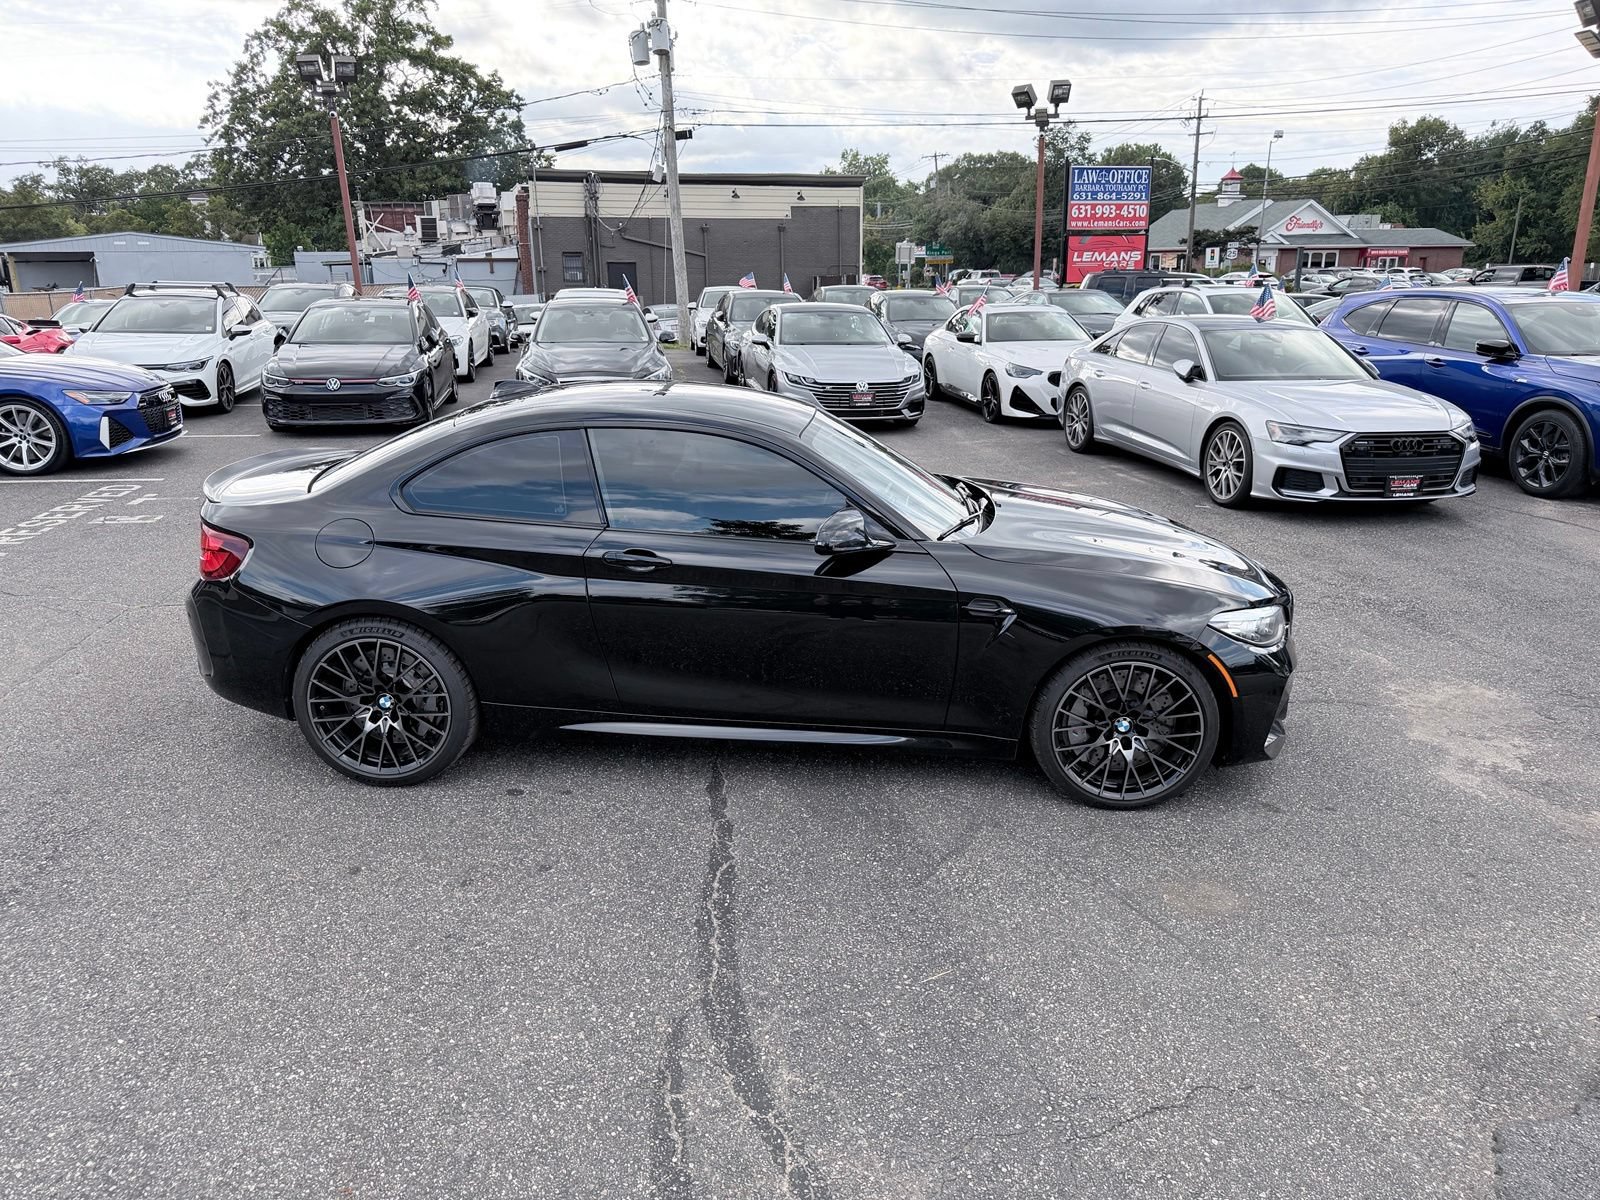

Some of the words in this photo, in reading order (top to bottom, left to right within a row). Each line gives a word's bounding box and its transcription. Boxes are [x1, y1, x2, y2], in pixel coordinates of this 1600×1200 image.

[1074, 169, 1099, 184] LAW
[1109, 169, 1149, 184] OFFICE
[1075, 184, 1104, 192] BARBARA
[1105, 184, 1137, 192] TOUHAMY
[1073, 192, 1146, 200] 631-864-5291
[1071, 205, 1147, 218] 631-993-4510
[1071, 219, 1146, 227] www.LemansCars.com
[1073, 251, 1142, 262] LEMANS
[1103, 261, 1135, 269] CARS
[353, 627, 402, 637] MICHELIN
